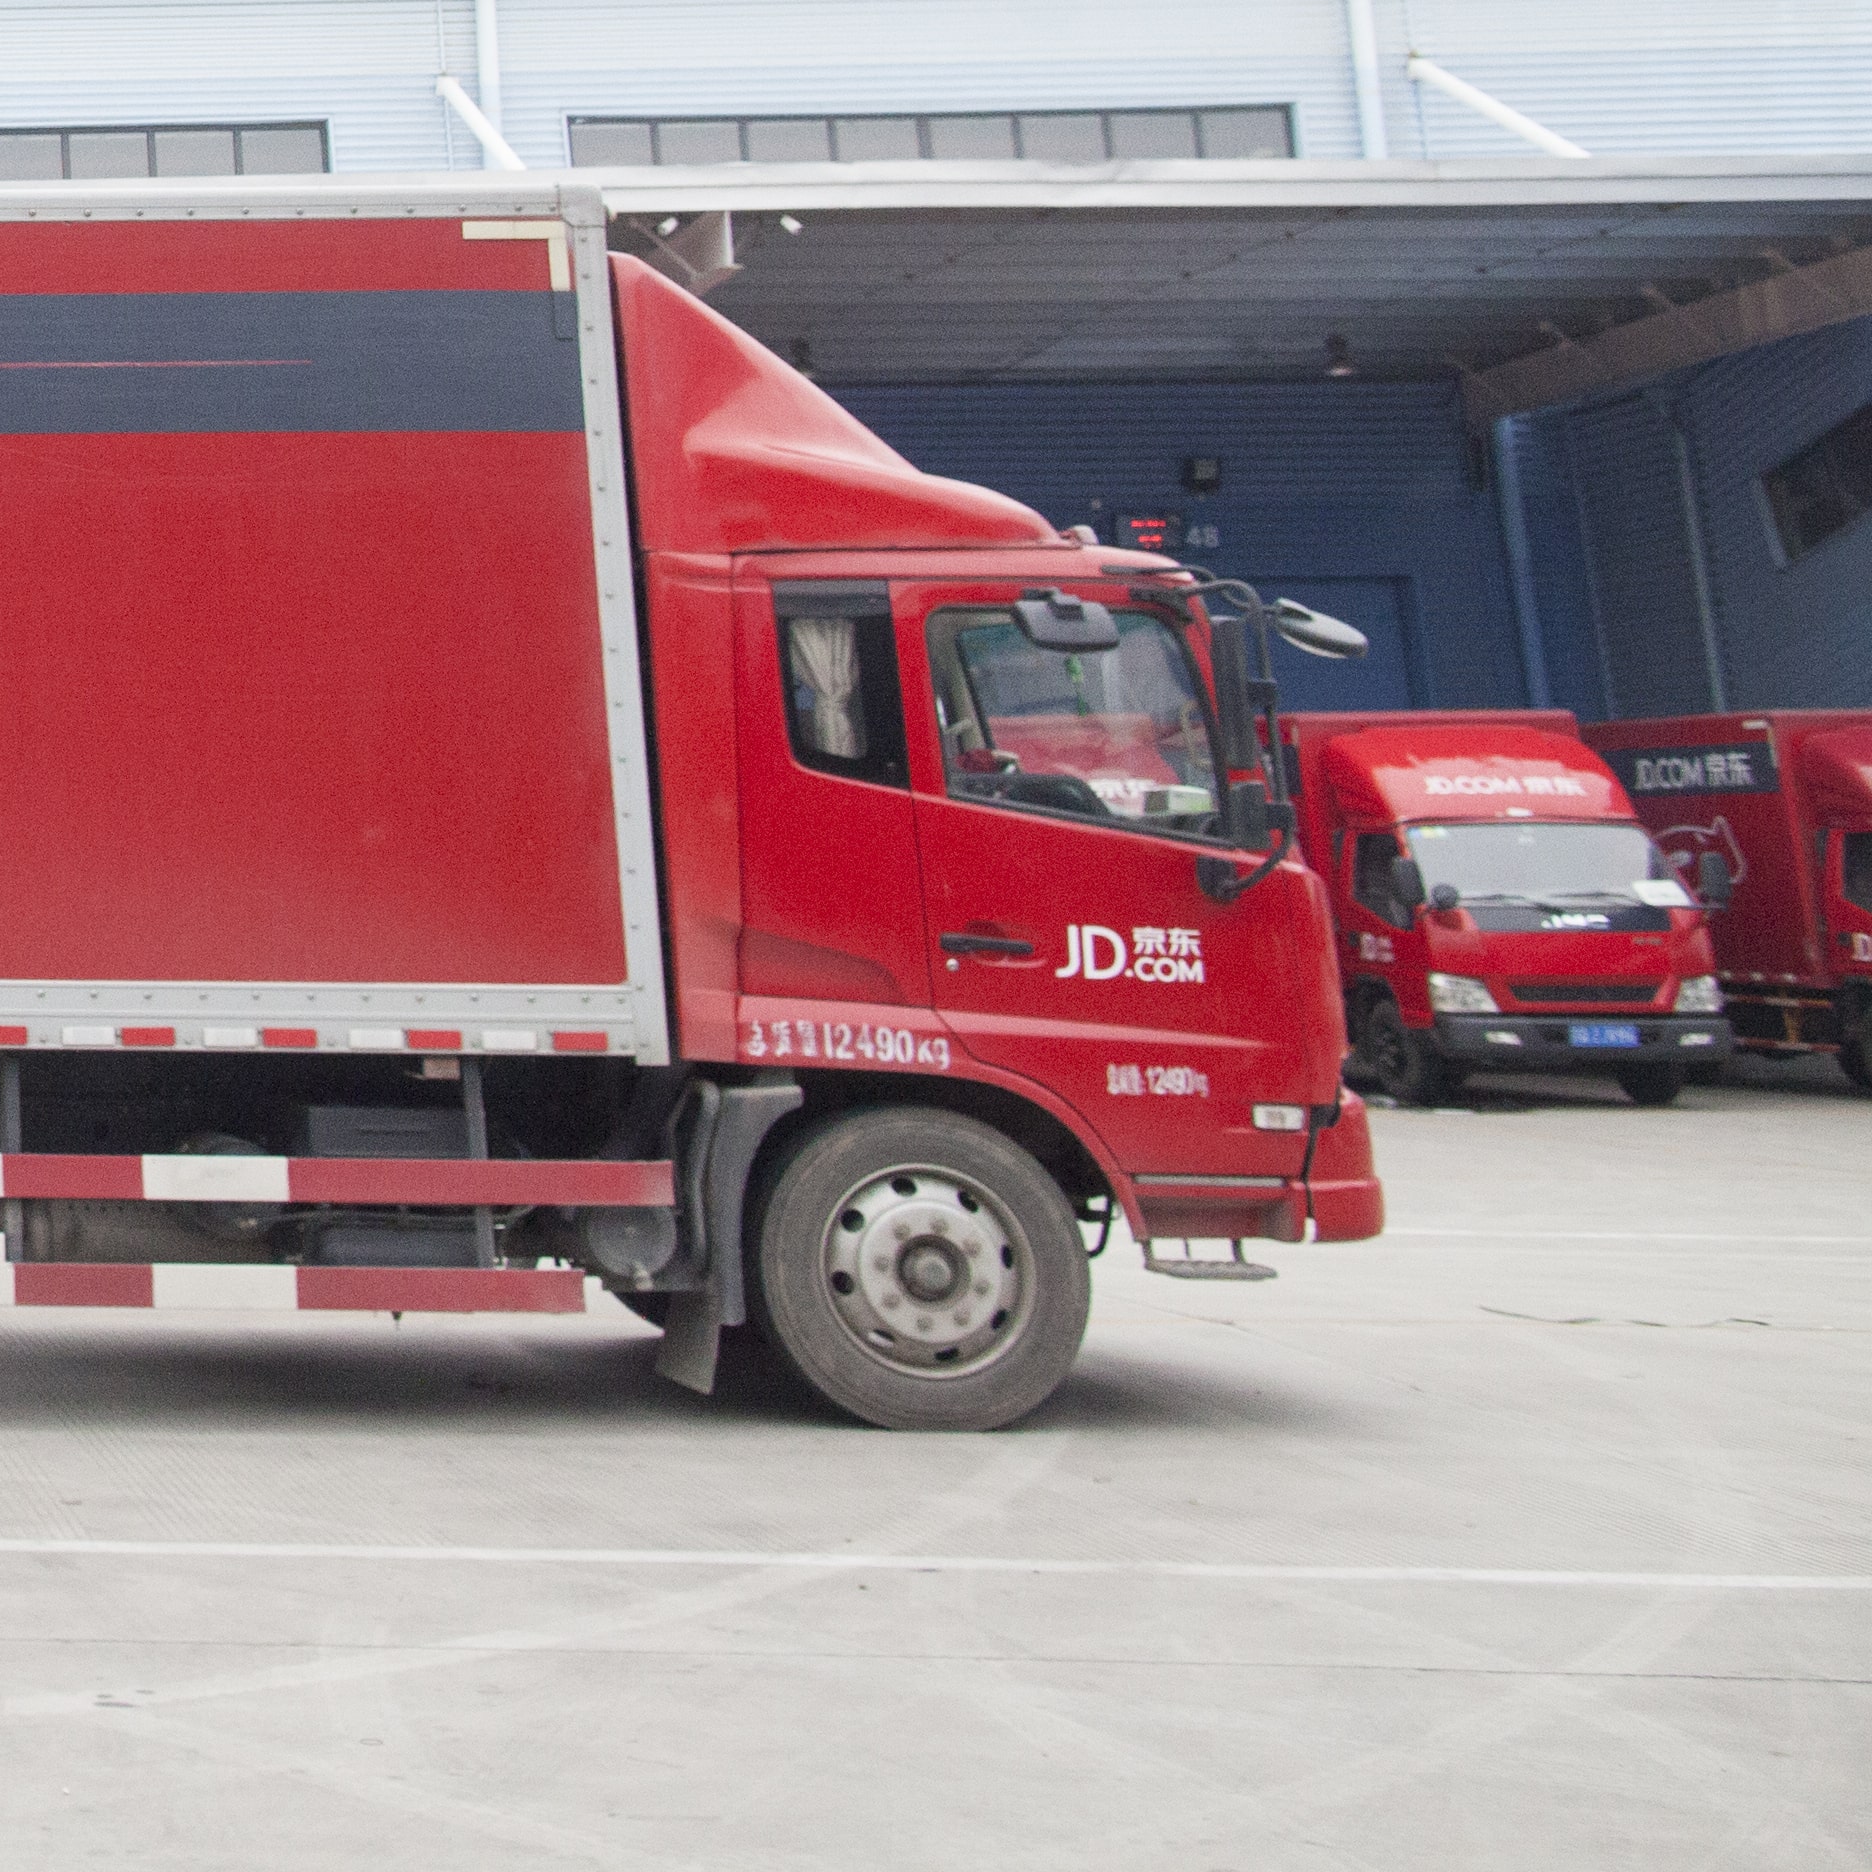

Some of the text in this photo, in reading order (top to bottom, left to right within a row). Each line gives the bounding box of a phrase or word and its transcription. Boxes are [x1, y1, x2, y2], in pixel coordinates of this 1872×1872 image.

[1635, 753, 1753, 790] JD.COM 京东
[1132, 926, 1202, 957] 京东
